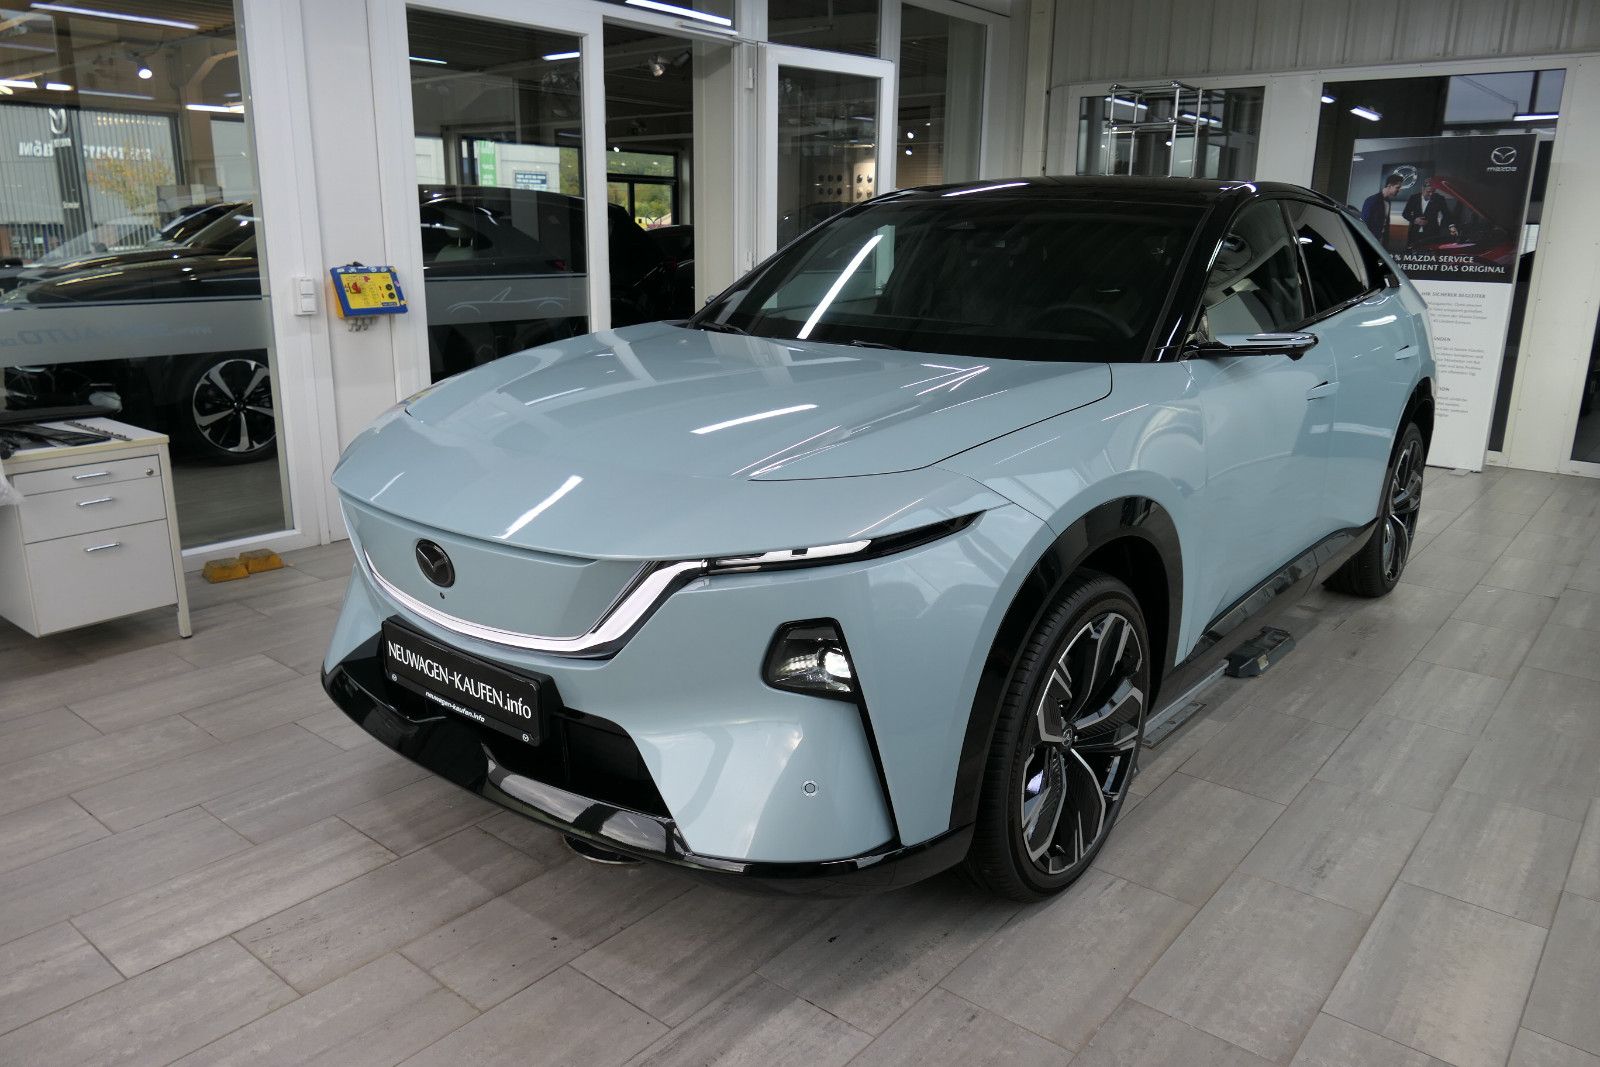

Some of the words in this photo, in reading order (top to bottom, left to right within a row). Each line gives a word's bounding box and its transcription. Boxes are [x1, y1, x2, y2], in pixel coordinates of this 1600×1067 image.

[1398, 263, 1439, 271] VERDIENT
[1460, 265, 1505, 274] ORIGINAL
[1403, 254, 1436, 262] MAZDA
[1438, 255, 1474, 263] SERVICE
[388, 640, 532, 719] NEUWAGEN-KAUFEN.info
[425, 691, 485, 723] neuwagen-kaufen.info
